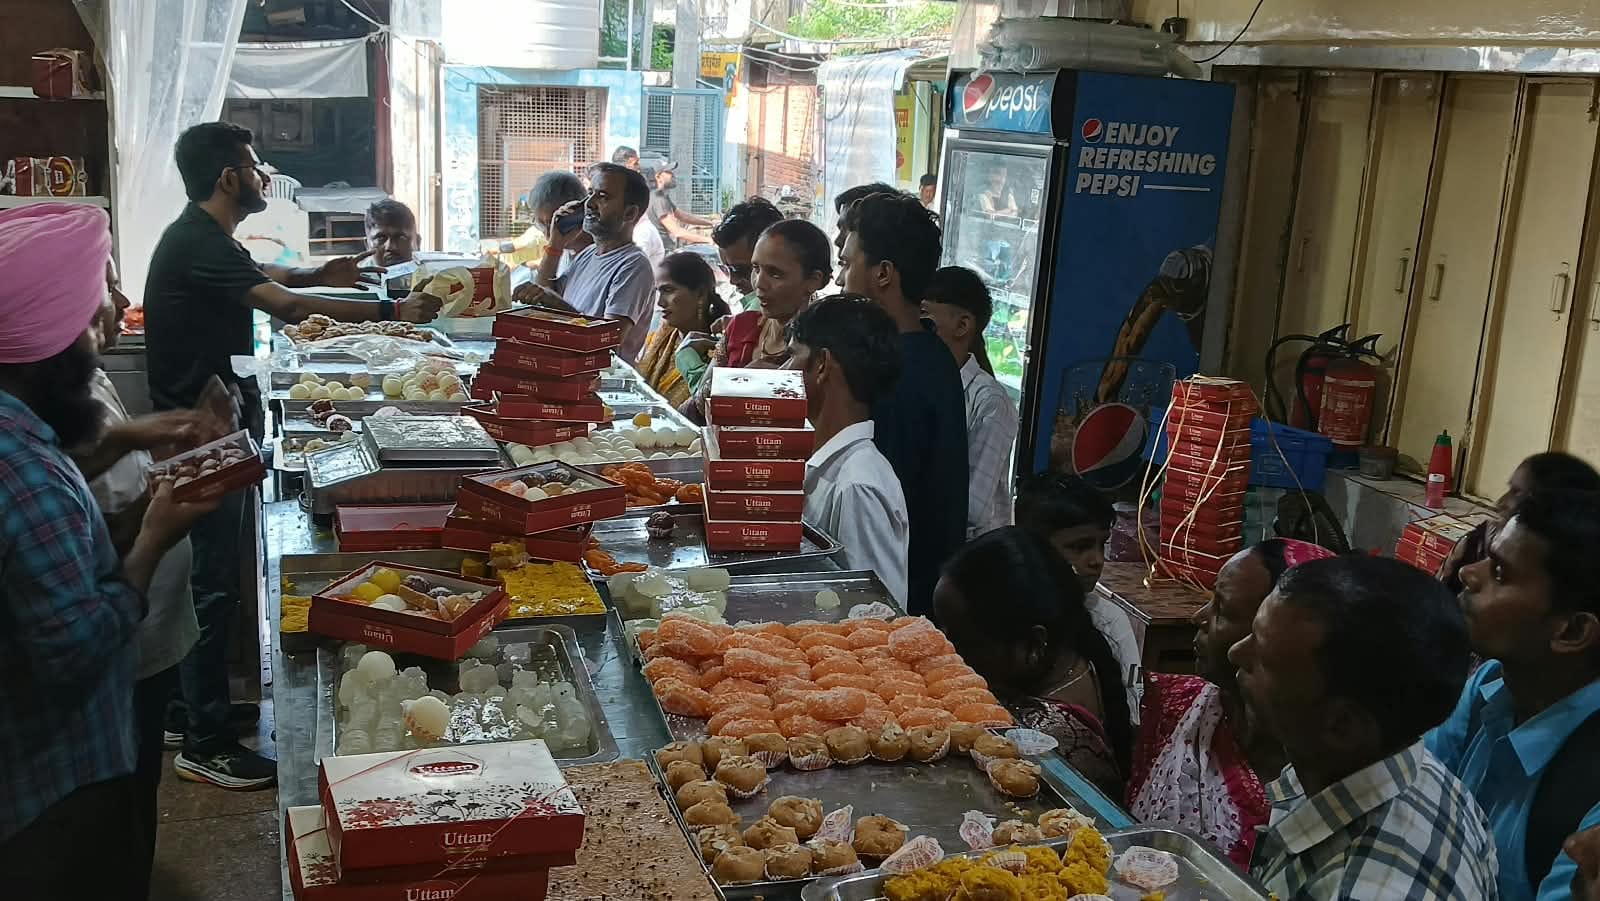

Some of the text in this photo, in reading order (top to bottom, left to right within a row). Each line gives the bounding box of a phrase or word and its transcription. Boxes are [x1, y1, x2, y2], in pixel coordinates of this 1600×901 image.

[985, 79, 1044, 119] pepsi
[1104, 122, 1180, 147] ENJOY
[1077, 146, 1217, 176] REFRESHING
[1075, 173, 1140, 196] PEPSI
[744, 402, 771, 411] Uttam
[755, 437, 782, 445] Uttam
[744, 466, 771, 475] Uttam
[745, 498, 771, 507] Uttam
[742, 528, 768, 536] Uttam
[363, 628, 394, 644] Uttam
[444, 832, 492, 846] Uttam
[406, 888, 455, 901] Uttam
